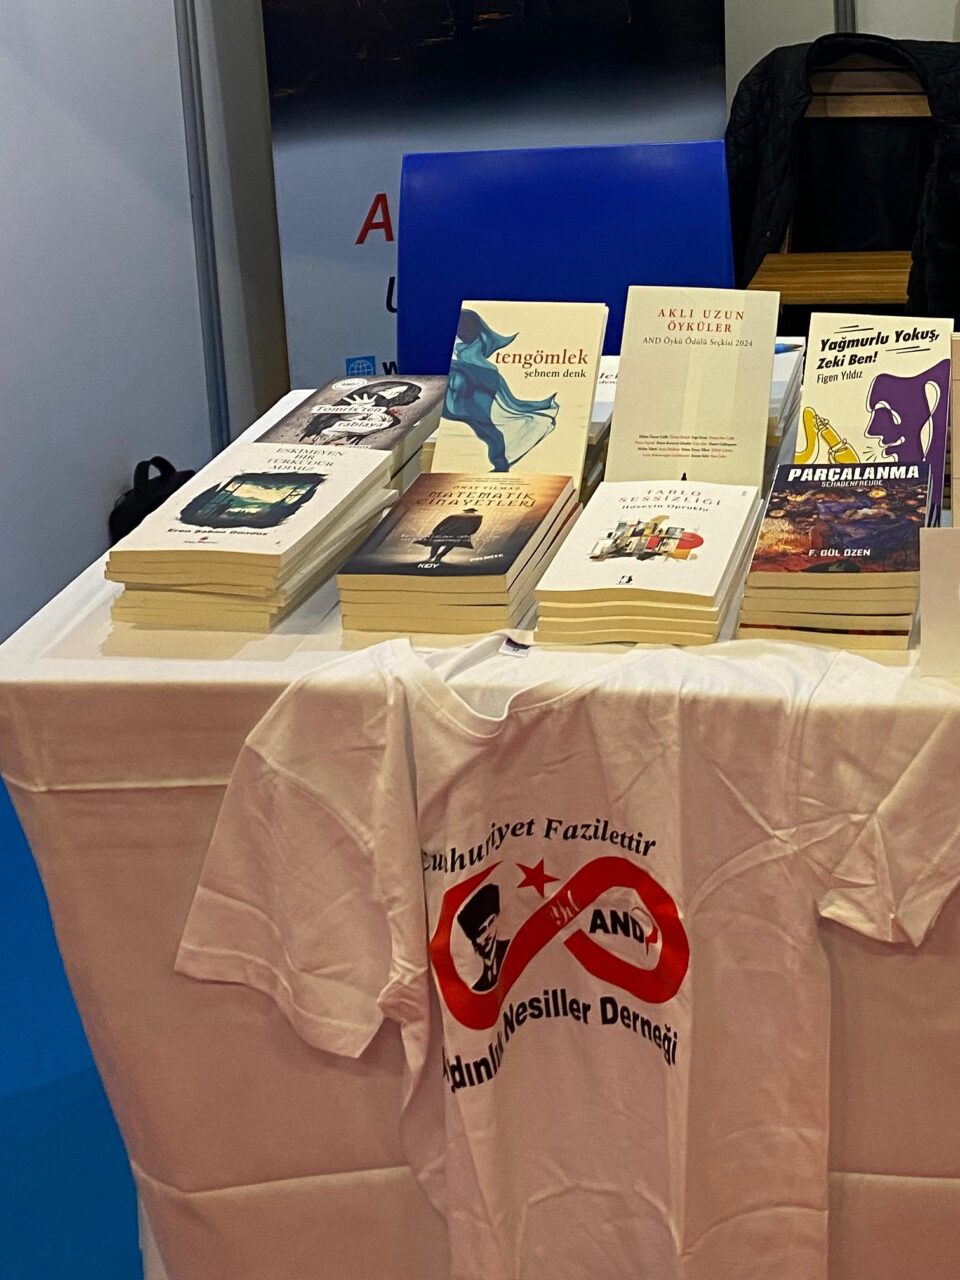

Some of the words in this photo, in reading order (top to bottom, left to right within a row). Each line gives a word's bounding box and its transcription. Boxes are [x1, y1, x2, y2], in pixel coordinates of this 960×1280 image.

[657, 308, 695, 319] AKLI
[702, 311, 745, 321] UZUN
[667, 320, 733, 334] ÖYKÜLER
[642, 336, 662, 345] AND
[663, 335, 683, 346] Öykü
[685, 335, 708, 346] Ödülü
[734, 338, 754, 347] 2024
[819, 331, 890, 353] Yağmurlu
[893, 327, 940, 344] Yokuş,
[495, 348, 589, 369] tengömlek
[816, 356, 846, 370] Zeki
[847, 351, 879, 367] Ben!
[524, 369, 561, 380] şebnem
[562, 369, 587, 379] denk
[816, 373, 839, 385] Figen
[840, 369, 863, 382] Yıldız
[787, 465, 920, 483] PARÇALANMA
[542, 817, 657, 858] Fazilettir
[588, 908, 646, 944] AND
[502, 988, 592, 1042] Nesiller
[599, 995, 679, 1067] Derneği
